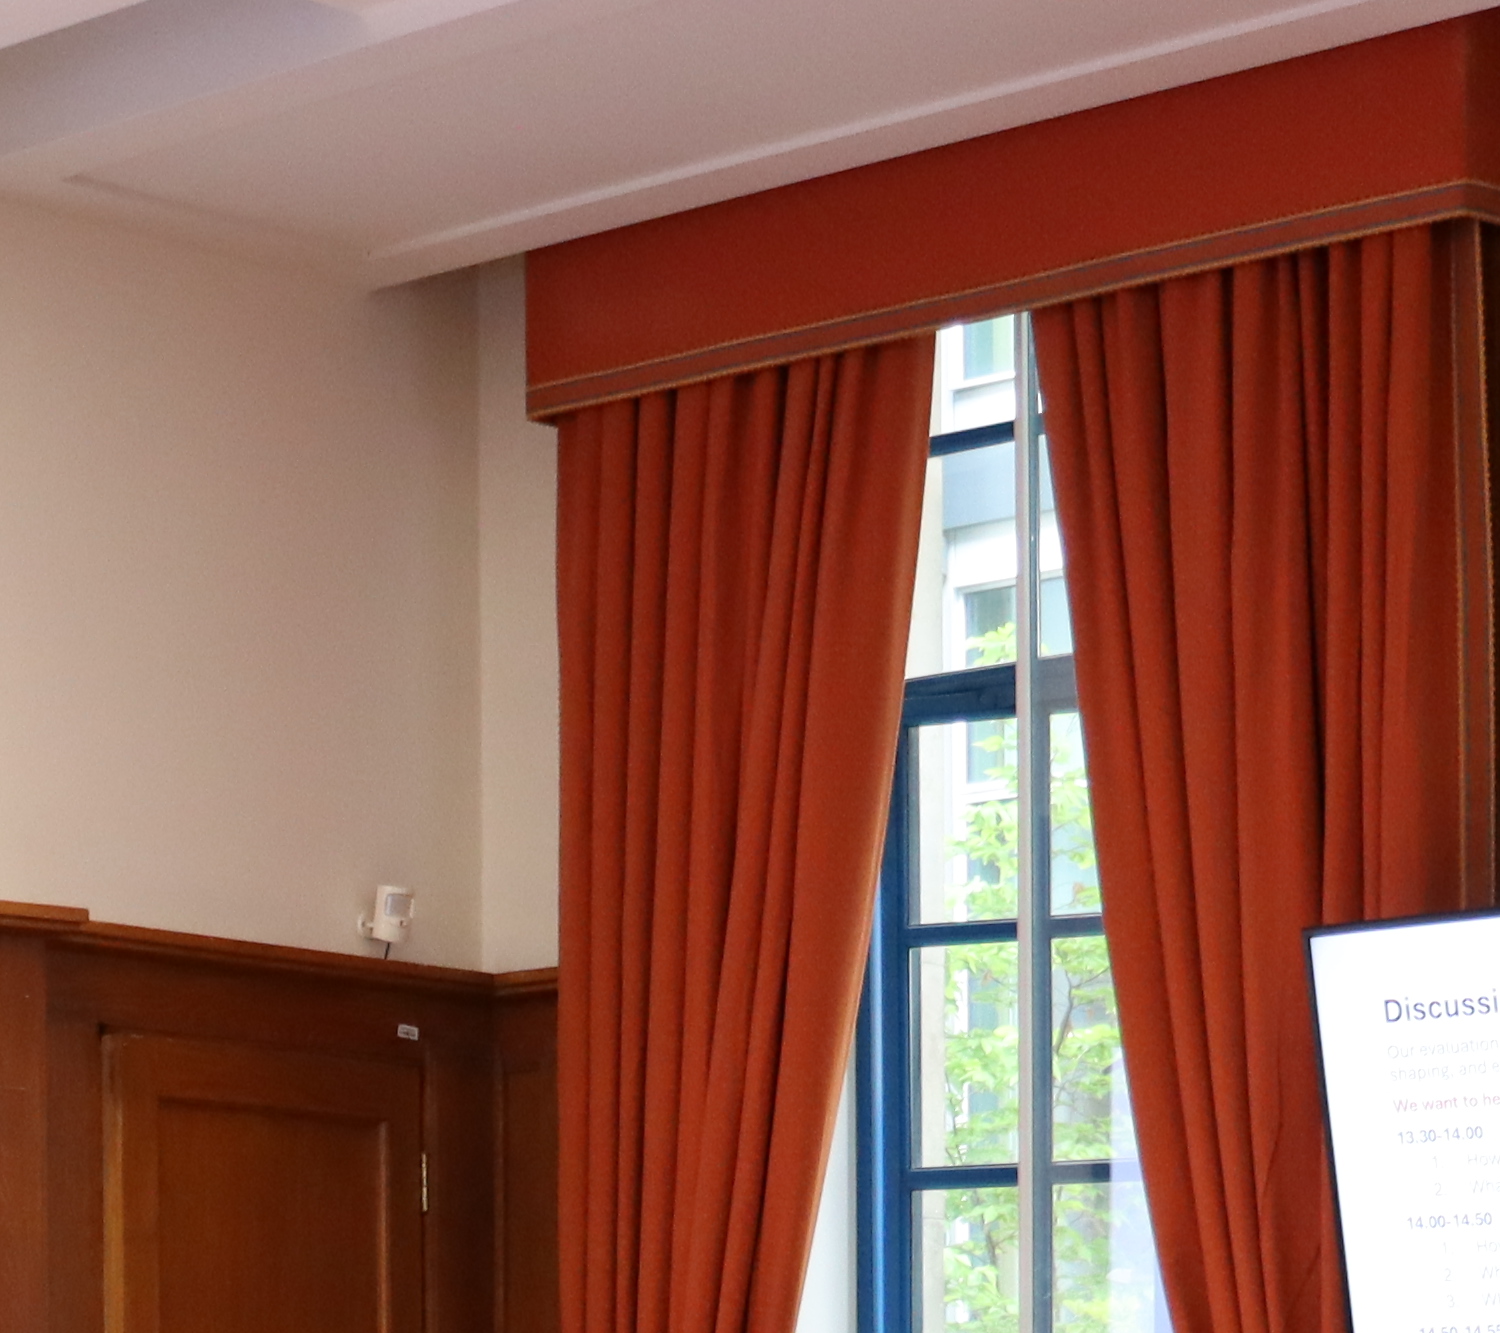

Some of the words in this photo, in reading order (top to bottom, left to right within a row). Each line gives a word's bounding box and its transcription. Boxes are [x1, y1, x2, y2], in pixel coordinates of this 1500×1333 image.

[1392, 1098, 1418, 1113] We
[1421, 1096, 1458, 1110] want
[1462, 1095, 1479, 1108] to
[1397, 1125, 1484, 1144] 13.30-14.00
[1407, 1211, 1493, 1229] 14.00-14.50
